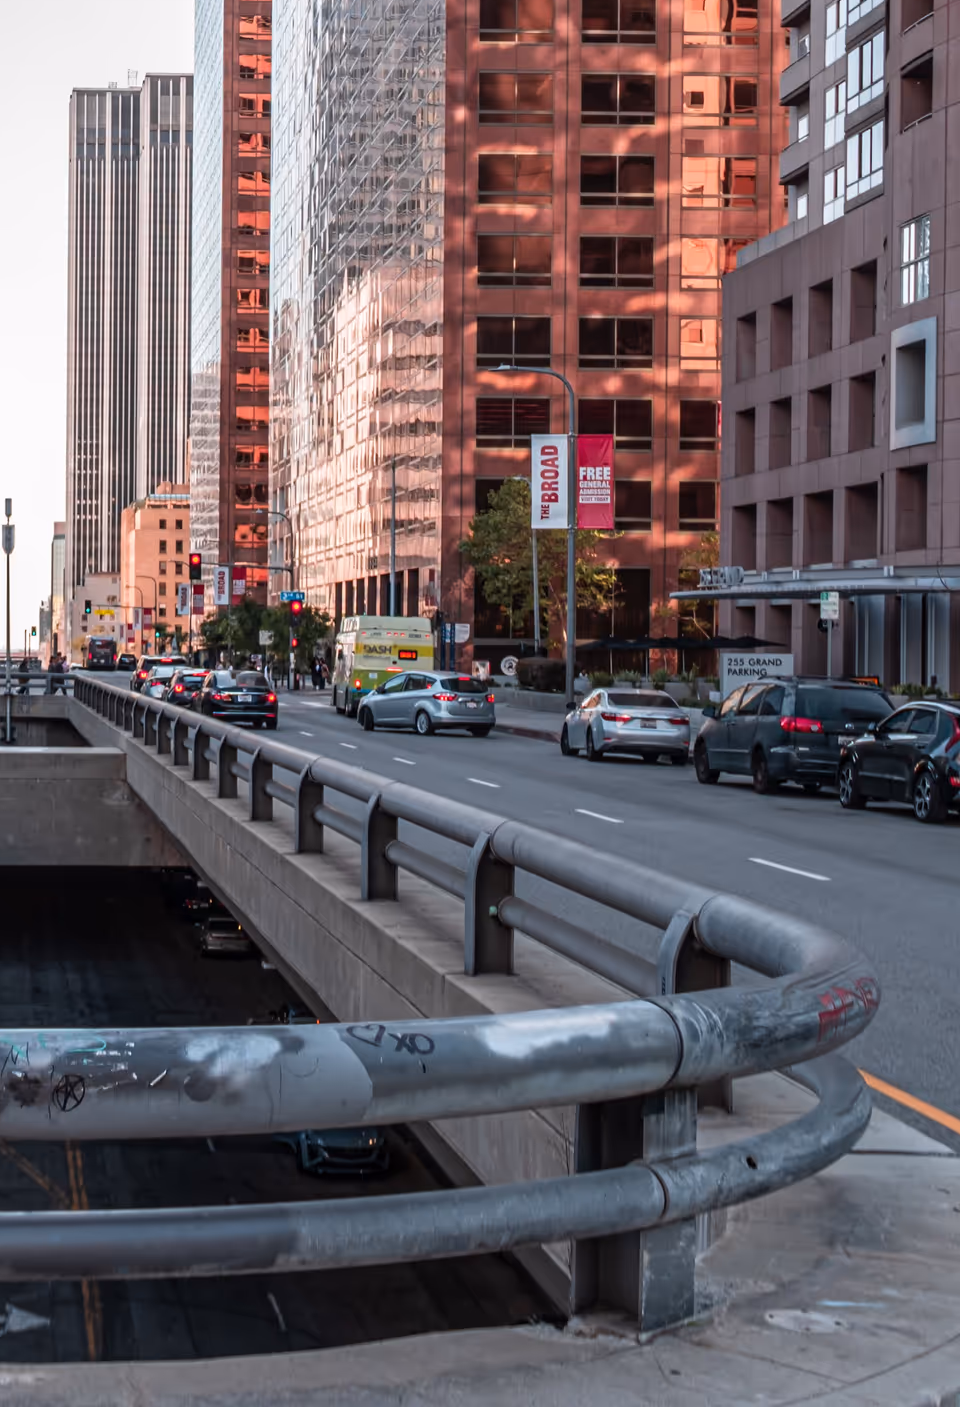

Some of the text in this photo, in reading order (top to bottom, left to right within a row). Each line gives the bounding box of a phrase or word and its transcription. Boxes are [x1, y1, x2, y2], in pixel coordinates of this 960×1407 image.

[579, 466, 611, 480] FREE
[540, 445, 559, 520] THE BROAD
[579, 480, 611, 489] GENERAL
[363, 644, 392, 654] DASH
[727, 657, 782, 667] 255 GRAND
[727, 668, 768, 677] PARKING
